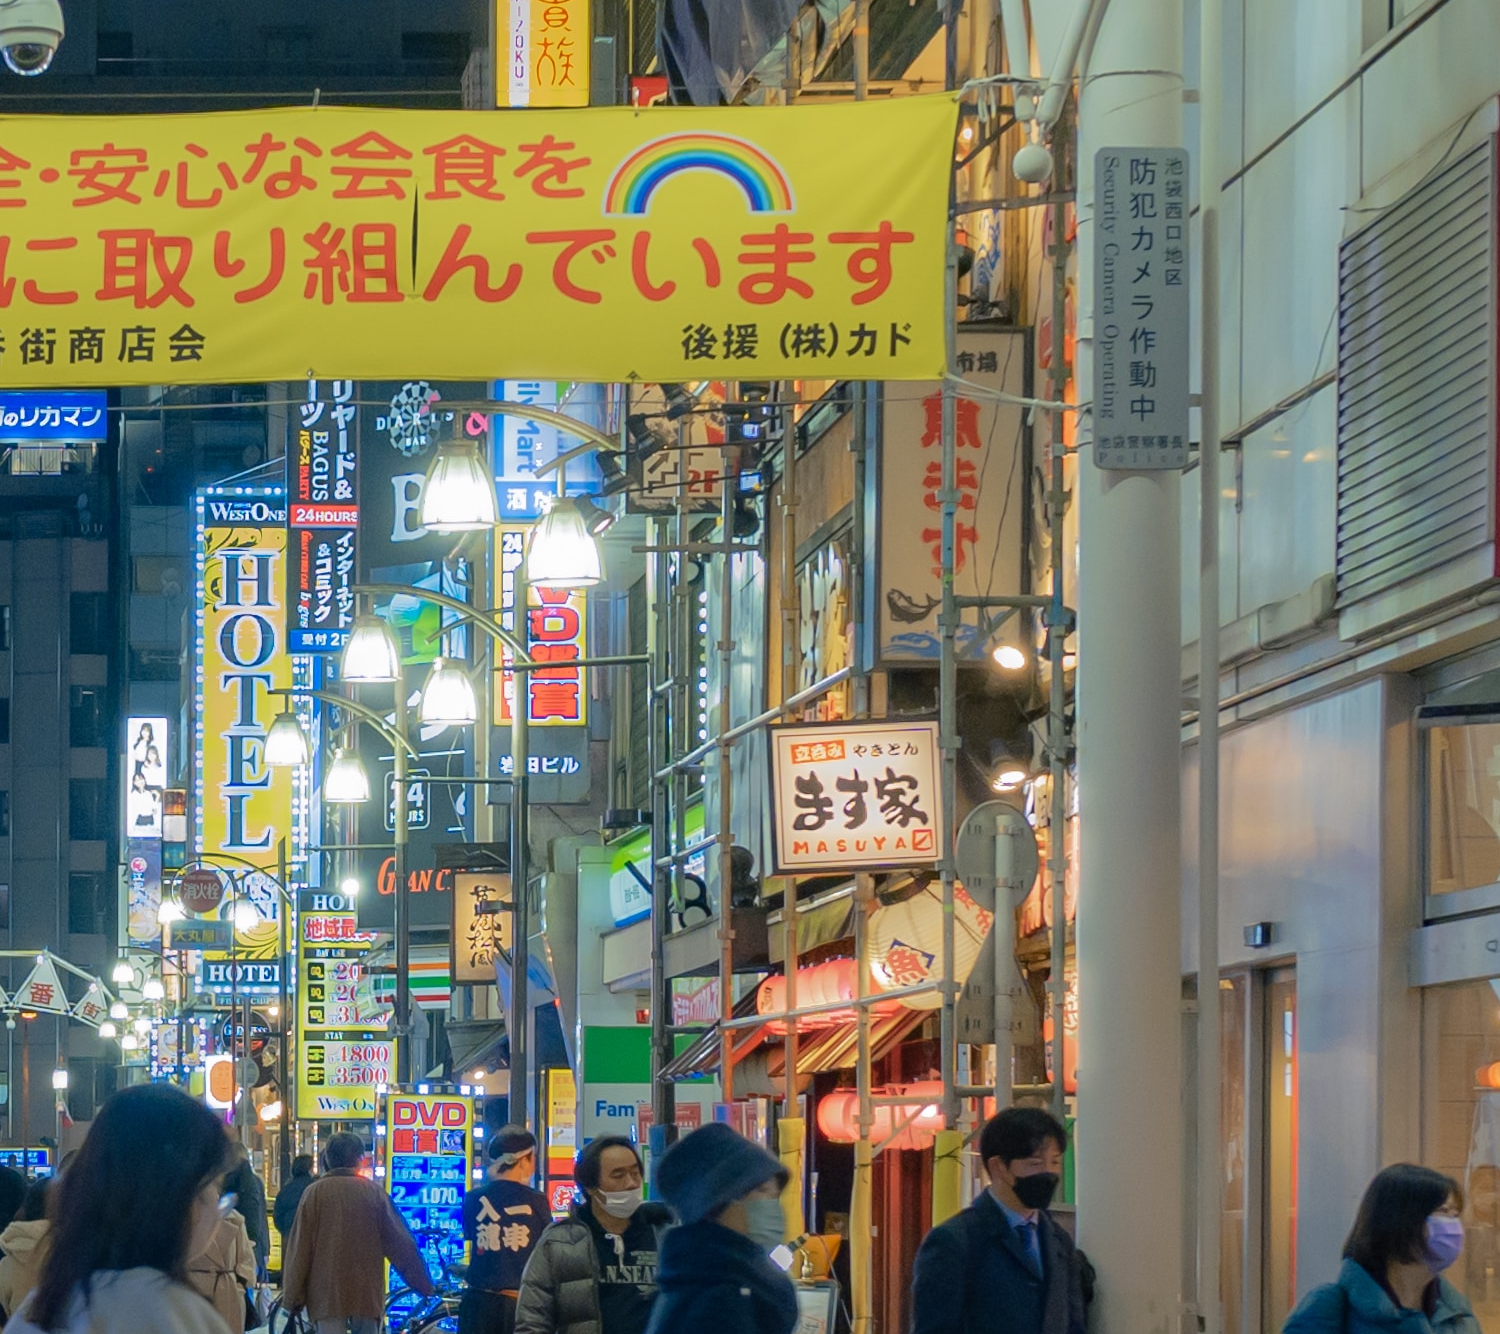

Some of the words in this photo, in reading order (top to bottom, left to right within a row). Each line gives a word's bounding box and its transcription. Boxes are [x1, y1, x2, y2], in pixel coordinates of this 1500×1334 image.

[1101, 157, 1119, 235] Security
[1165, 158, 1182, 286] 池袋西口地区
[1103, 242, 1119, 327] Camera
[1129, 158, 1157, 422] 防犯カメラ作動中
[681, 323, 760, 361] 後援
[779, 323, 913, 362] (株)カド
[1102, 327, 1120, 420] Operating
[405, 436, 426, 446] BAR
[1100, 436, 1183, 449] 池袋警察署長
[312, 431, 328, 501] BAGUS
[688, 470, 720, 492] 2F
[314, 543, 333, 622] &コミック
[336, 531, 354, 628] インターネット
[301, 633, 327, 646] 受付
[216, 549, 281, 848] HOTEL
[794, 742, 843, 762] 立呑み
[853, 742, 918, 758] やきとん
[793, 767, 928, 831] ます家
[793, 837, 907, 855] MASUYA
[183, 882, 220, 900] 消火栓
[377, 857, 433, 896] GAN
[393, 1101, 467, 1126] DVD
[393, 1129, 438, 1154] 鑑賞
[502, 1204, 533, 1252] 一串
